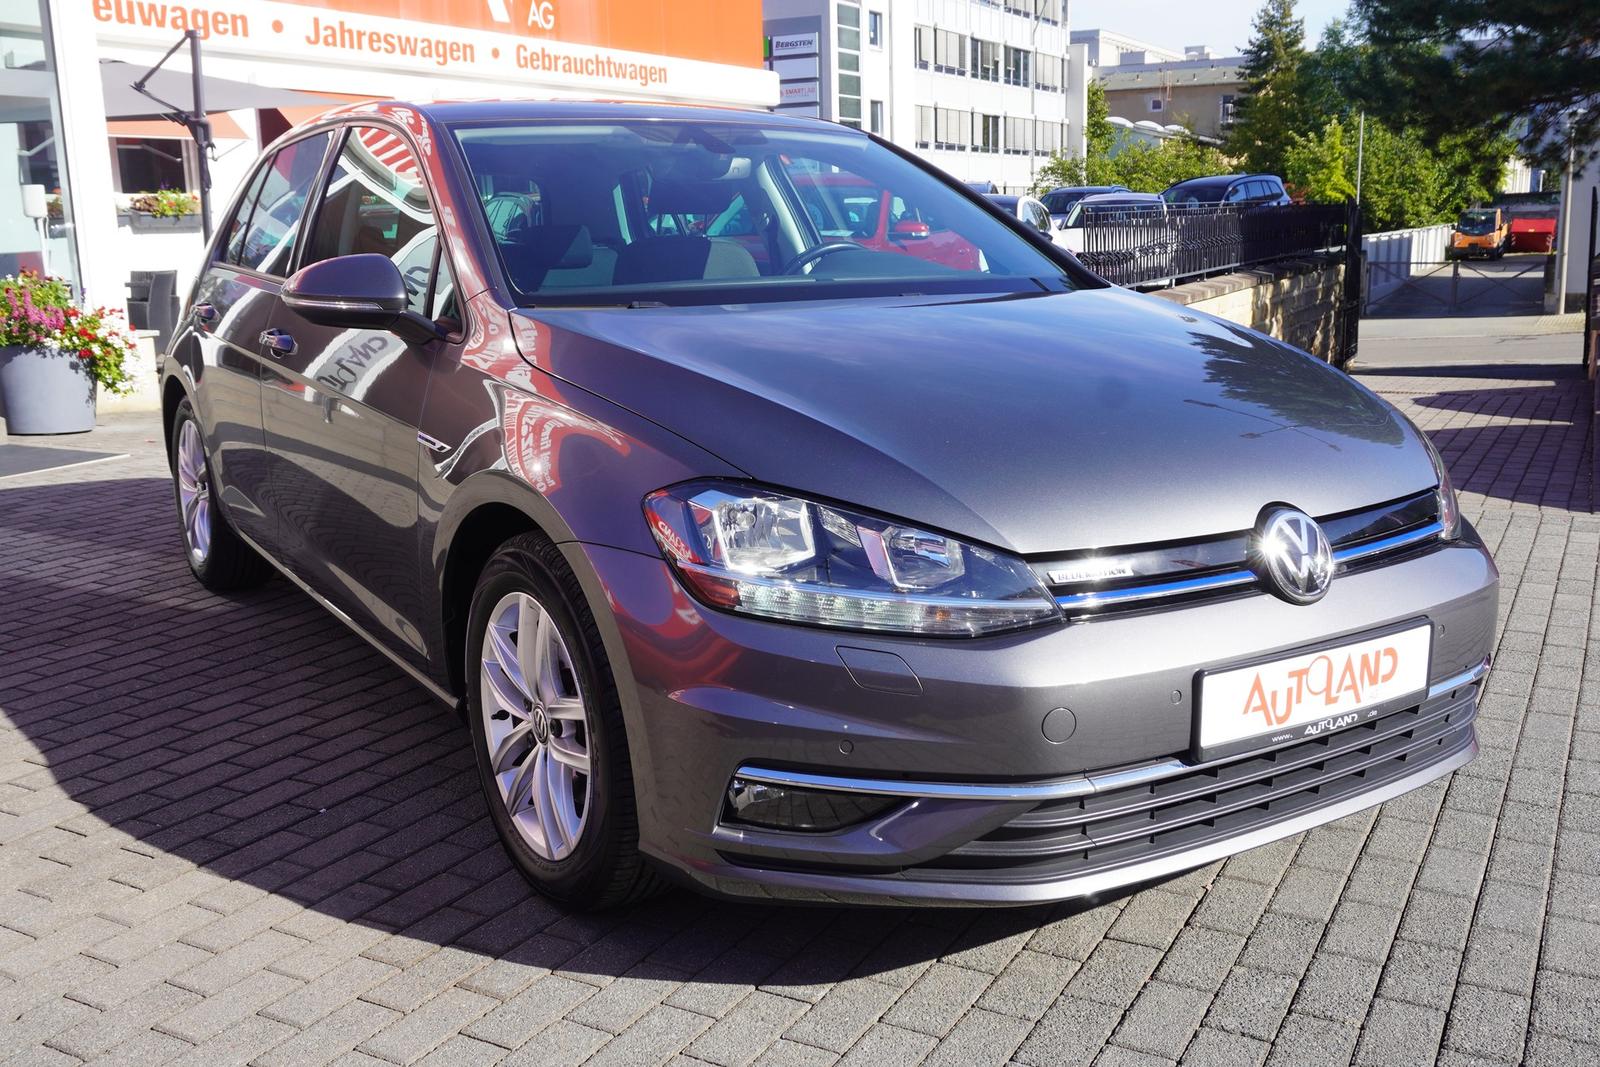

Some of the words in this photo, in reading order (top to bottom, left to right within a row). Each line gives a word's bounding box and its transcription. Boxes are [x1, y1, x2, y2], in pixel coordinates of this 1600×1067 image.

[528, 2, 555, 29] AG
[305, 17, 475, 65] Jahreswagen
[515, 44, 668, 87] Gebrauchtwagen
[775, 40, 814, 49] BERGSTEN
